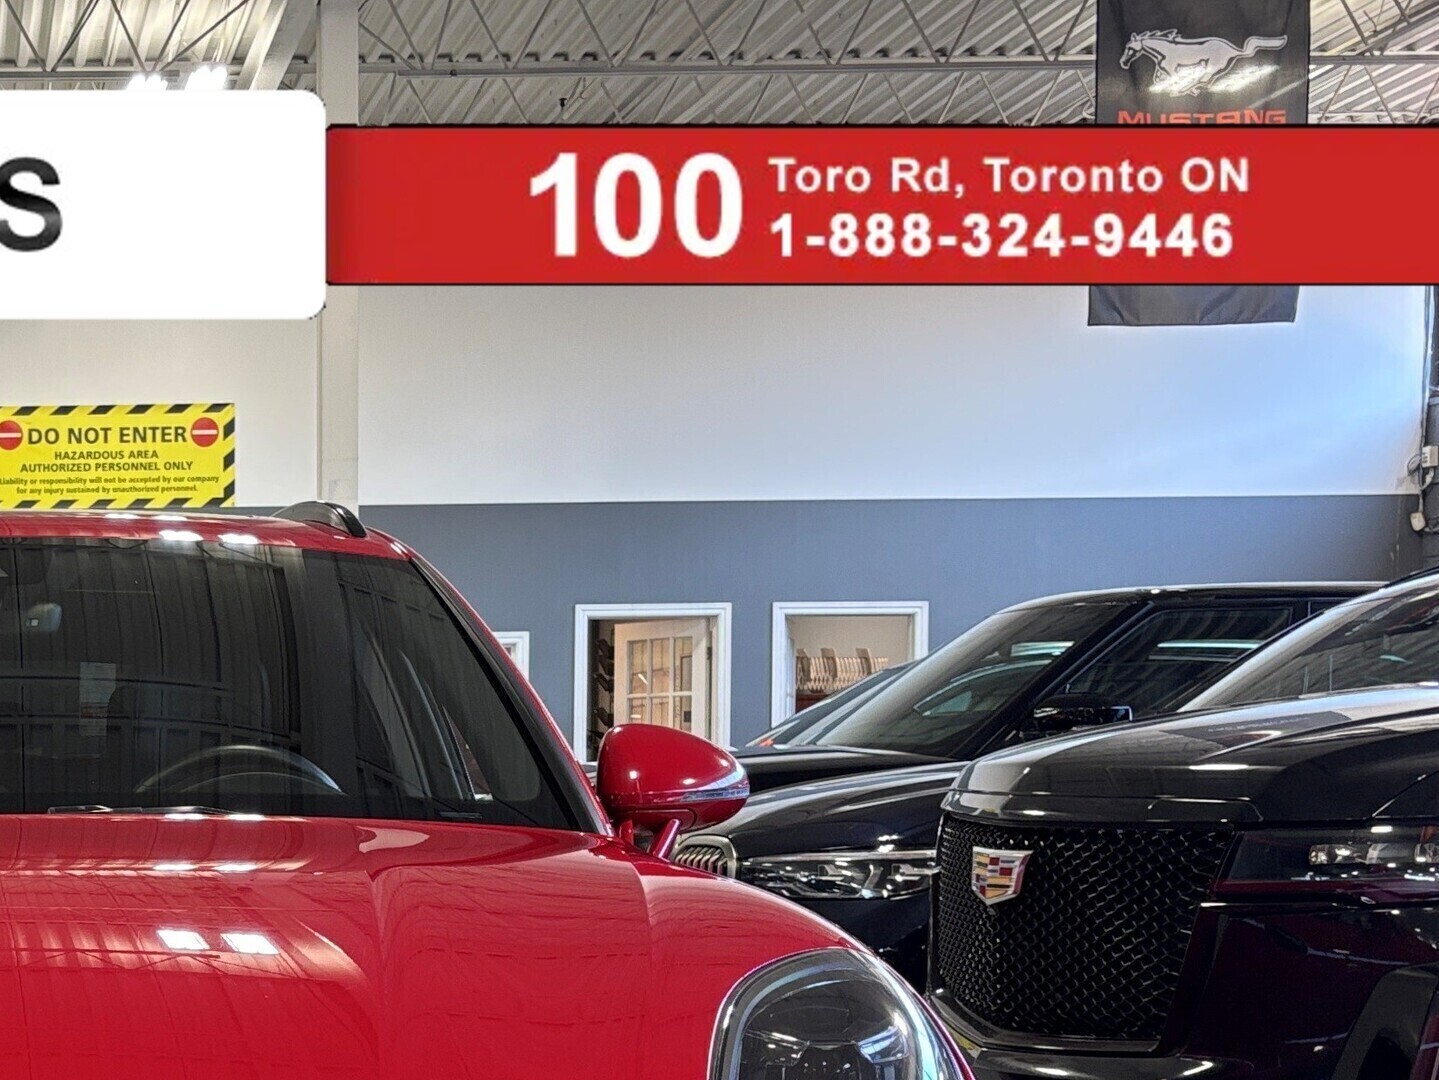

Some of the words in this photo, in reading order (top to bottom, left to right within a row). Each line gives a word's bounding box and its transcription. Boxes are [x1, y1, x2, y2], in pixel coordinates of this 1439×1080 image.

[27, 428, 59, 445] DO
[67, 427, 111, 445] NOT
[119, 426, 188, 443] ENTER
[54, 450, 124, 460] HAZARDOUS
[128, 450, 159, 459] AREA
[20, 463, 91, 473] AUTHORIZED
[95, 461, 160, 471] PERSONNEL
[163, 461, 193, 471] ONLY
[39, 477, 88, 486] responsibility
[128, 475, 161, 484] accepted
[162, 475, 171, 484] by
[44, 486, 64, 495] injury
[101, 486, 111, 494] by
[112, 485, 159, 493] unauthorized
